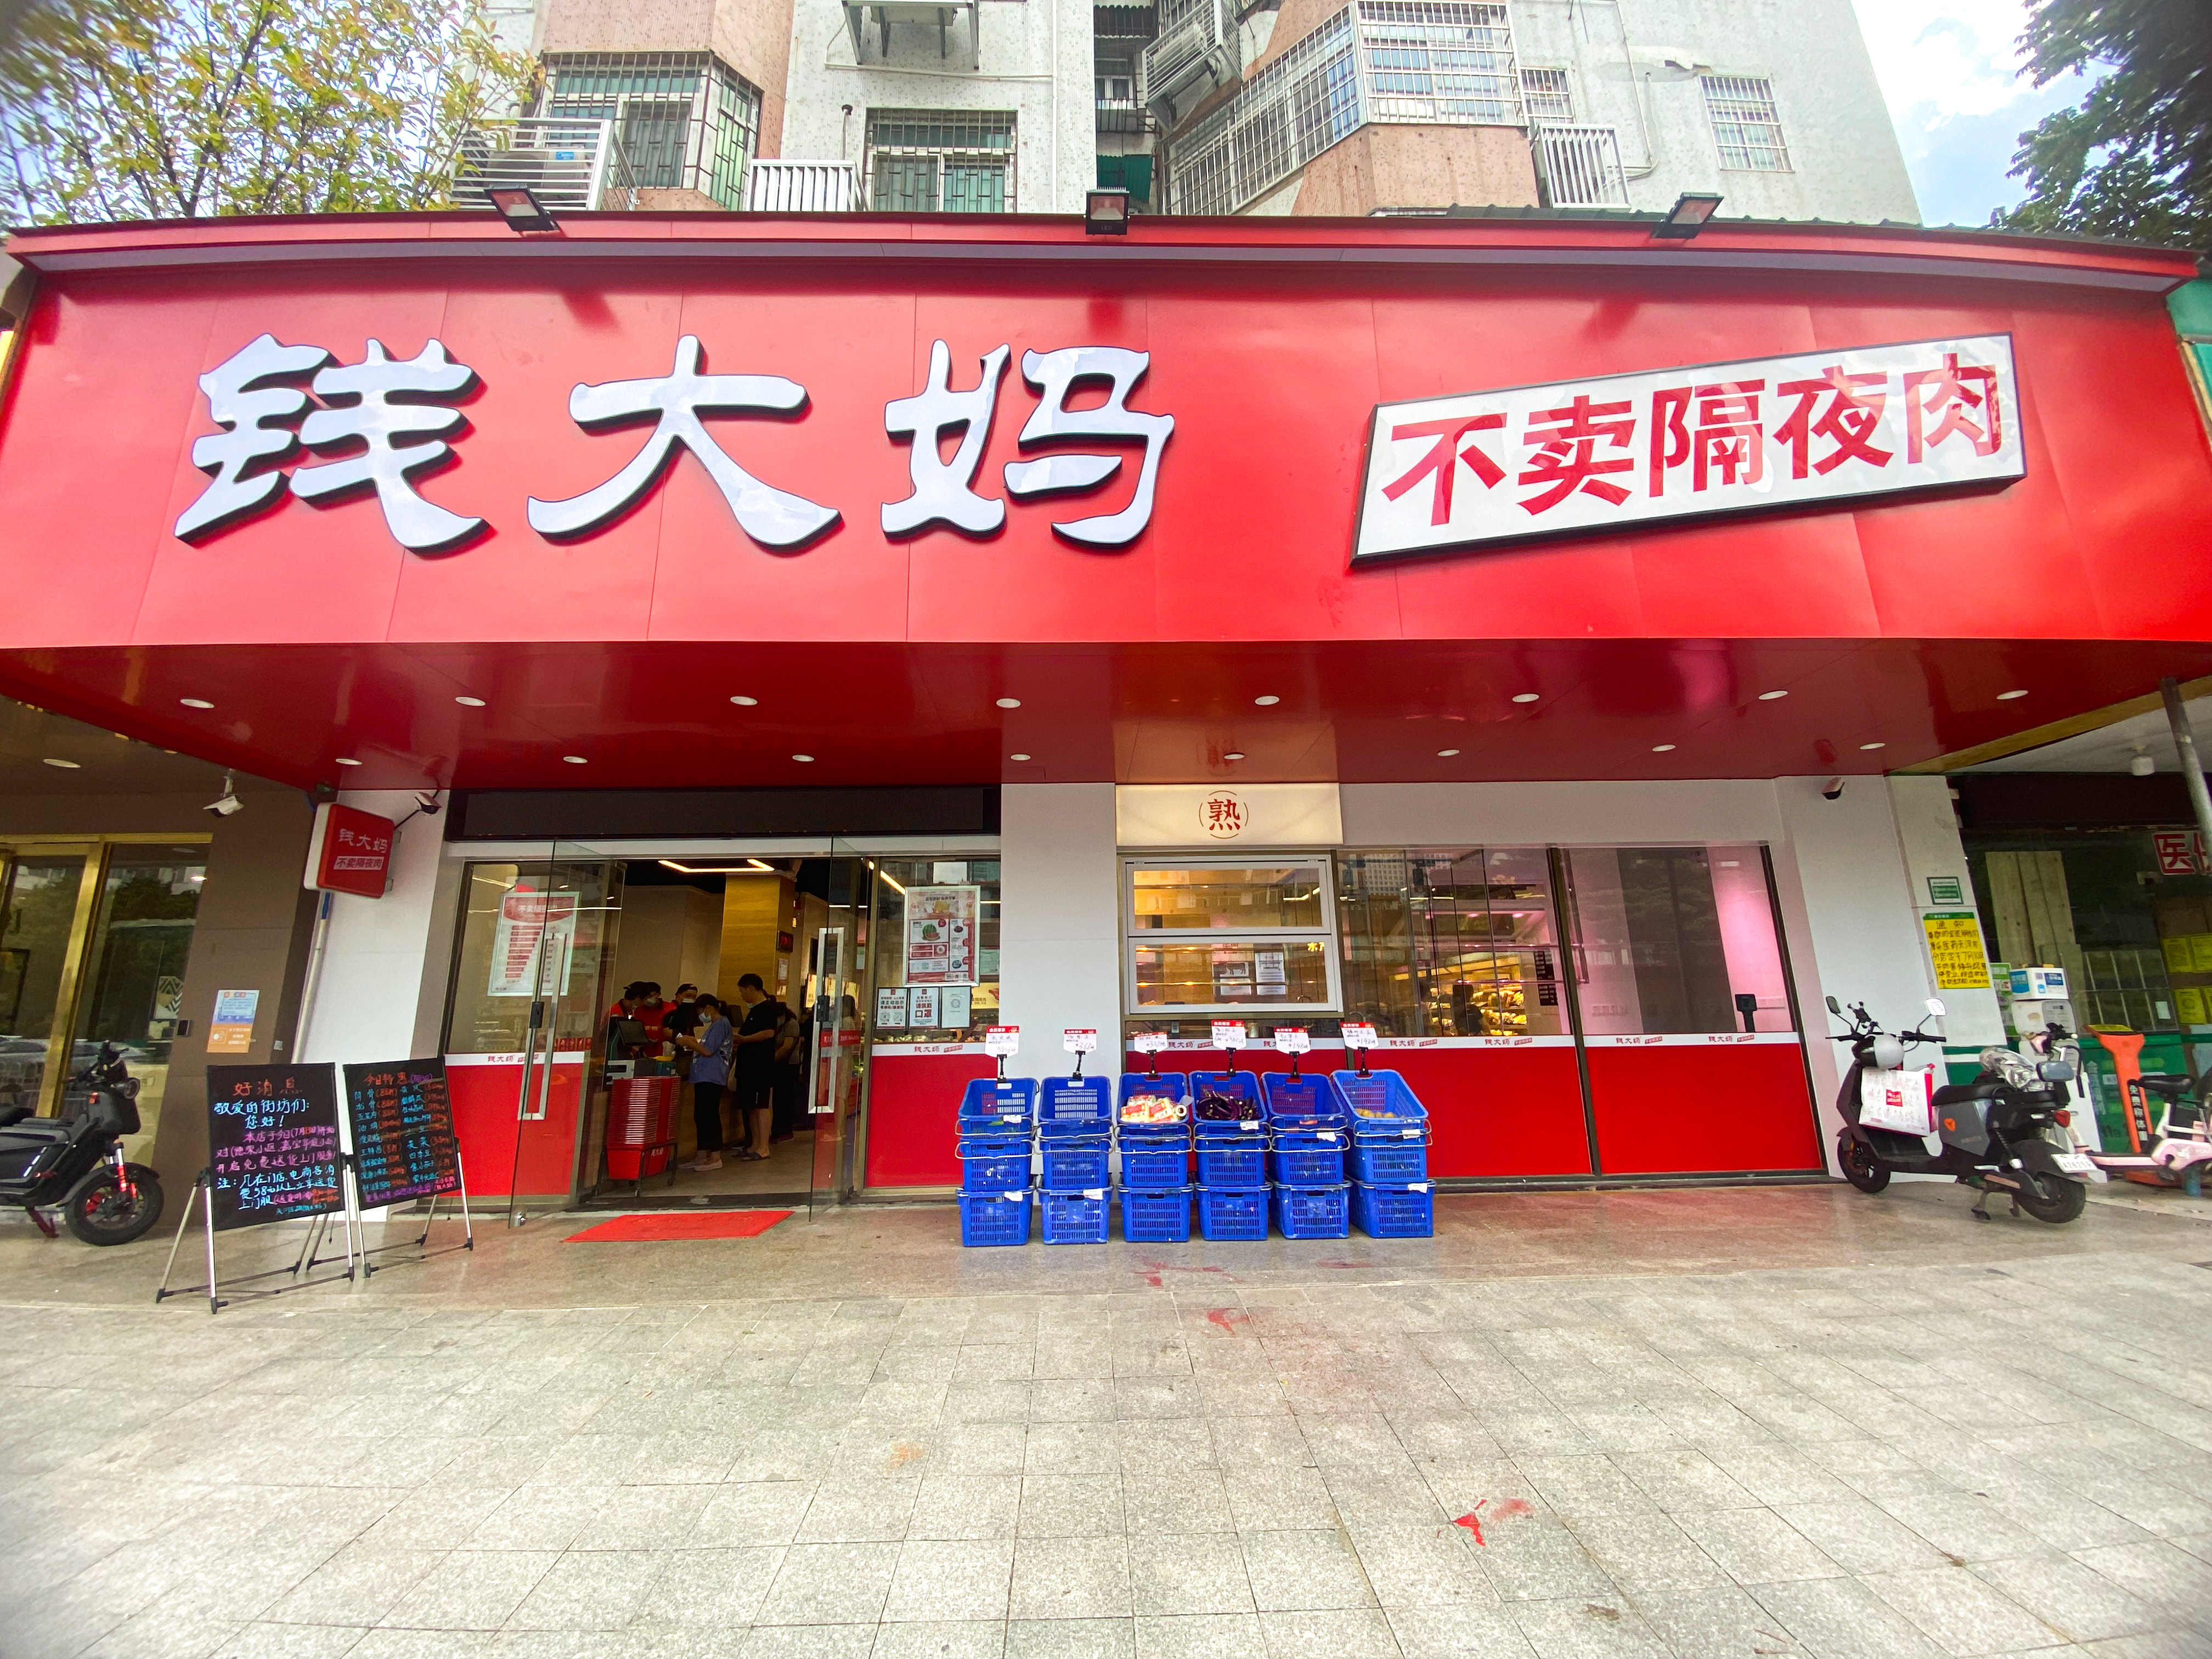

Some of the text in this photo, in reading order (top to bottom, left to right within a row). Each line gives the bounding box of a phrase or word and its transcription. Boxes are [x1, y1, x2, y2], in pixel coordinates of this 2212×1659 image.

[174, 332, 1175, 553] 钱大妈
[1381, 352, 2003, 527] 不卖隔夜肉
[1207, 798, 1241, 831] 熟
[338, 828, 388, 854] 钱大妈
[337, 857, 383, 869] 不卖隔夜肉
[233, 1076, 303, 1097] 好消息
[213, 1098, 310, 1115] 敬爱的街坊们:
[245, 1115, 285, 1130] 您好!
